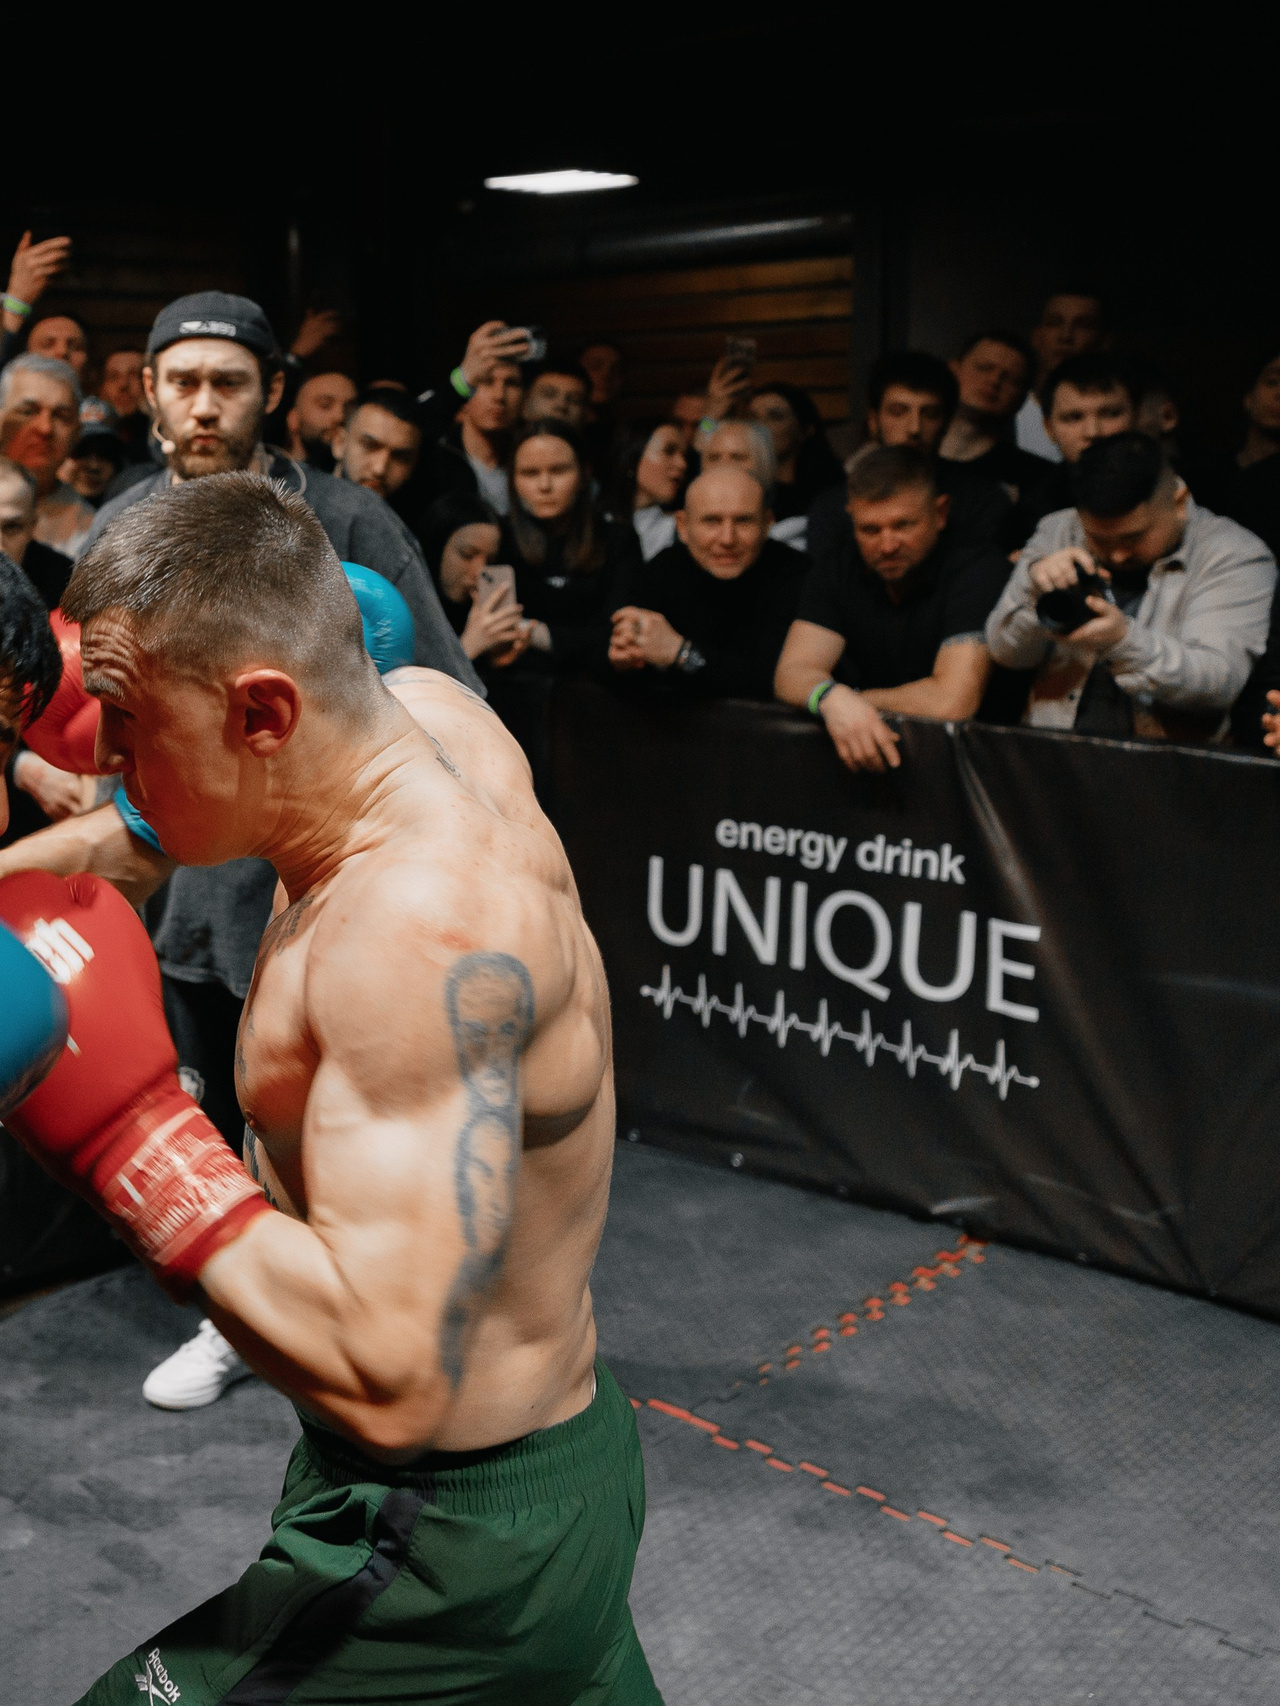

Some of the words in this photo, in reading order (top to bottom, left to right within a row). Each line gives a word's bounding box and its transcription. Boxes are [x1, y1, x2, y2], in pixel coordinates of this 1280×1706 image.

[716, 818, 848, 874] energy
[856, 833, 966, 885] drink
[647, 854, 1042, 1023] UNIQUE
[148, 1647, 181, 1703] Reebok
